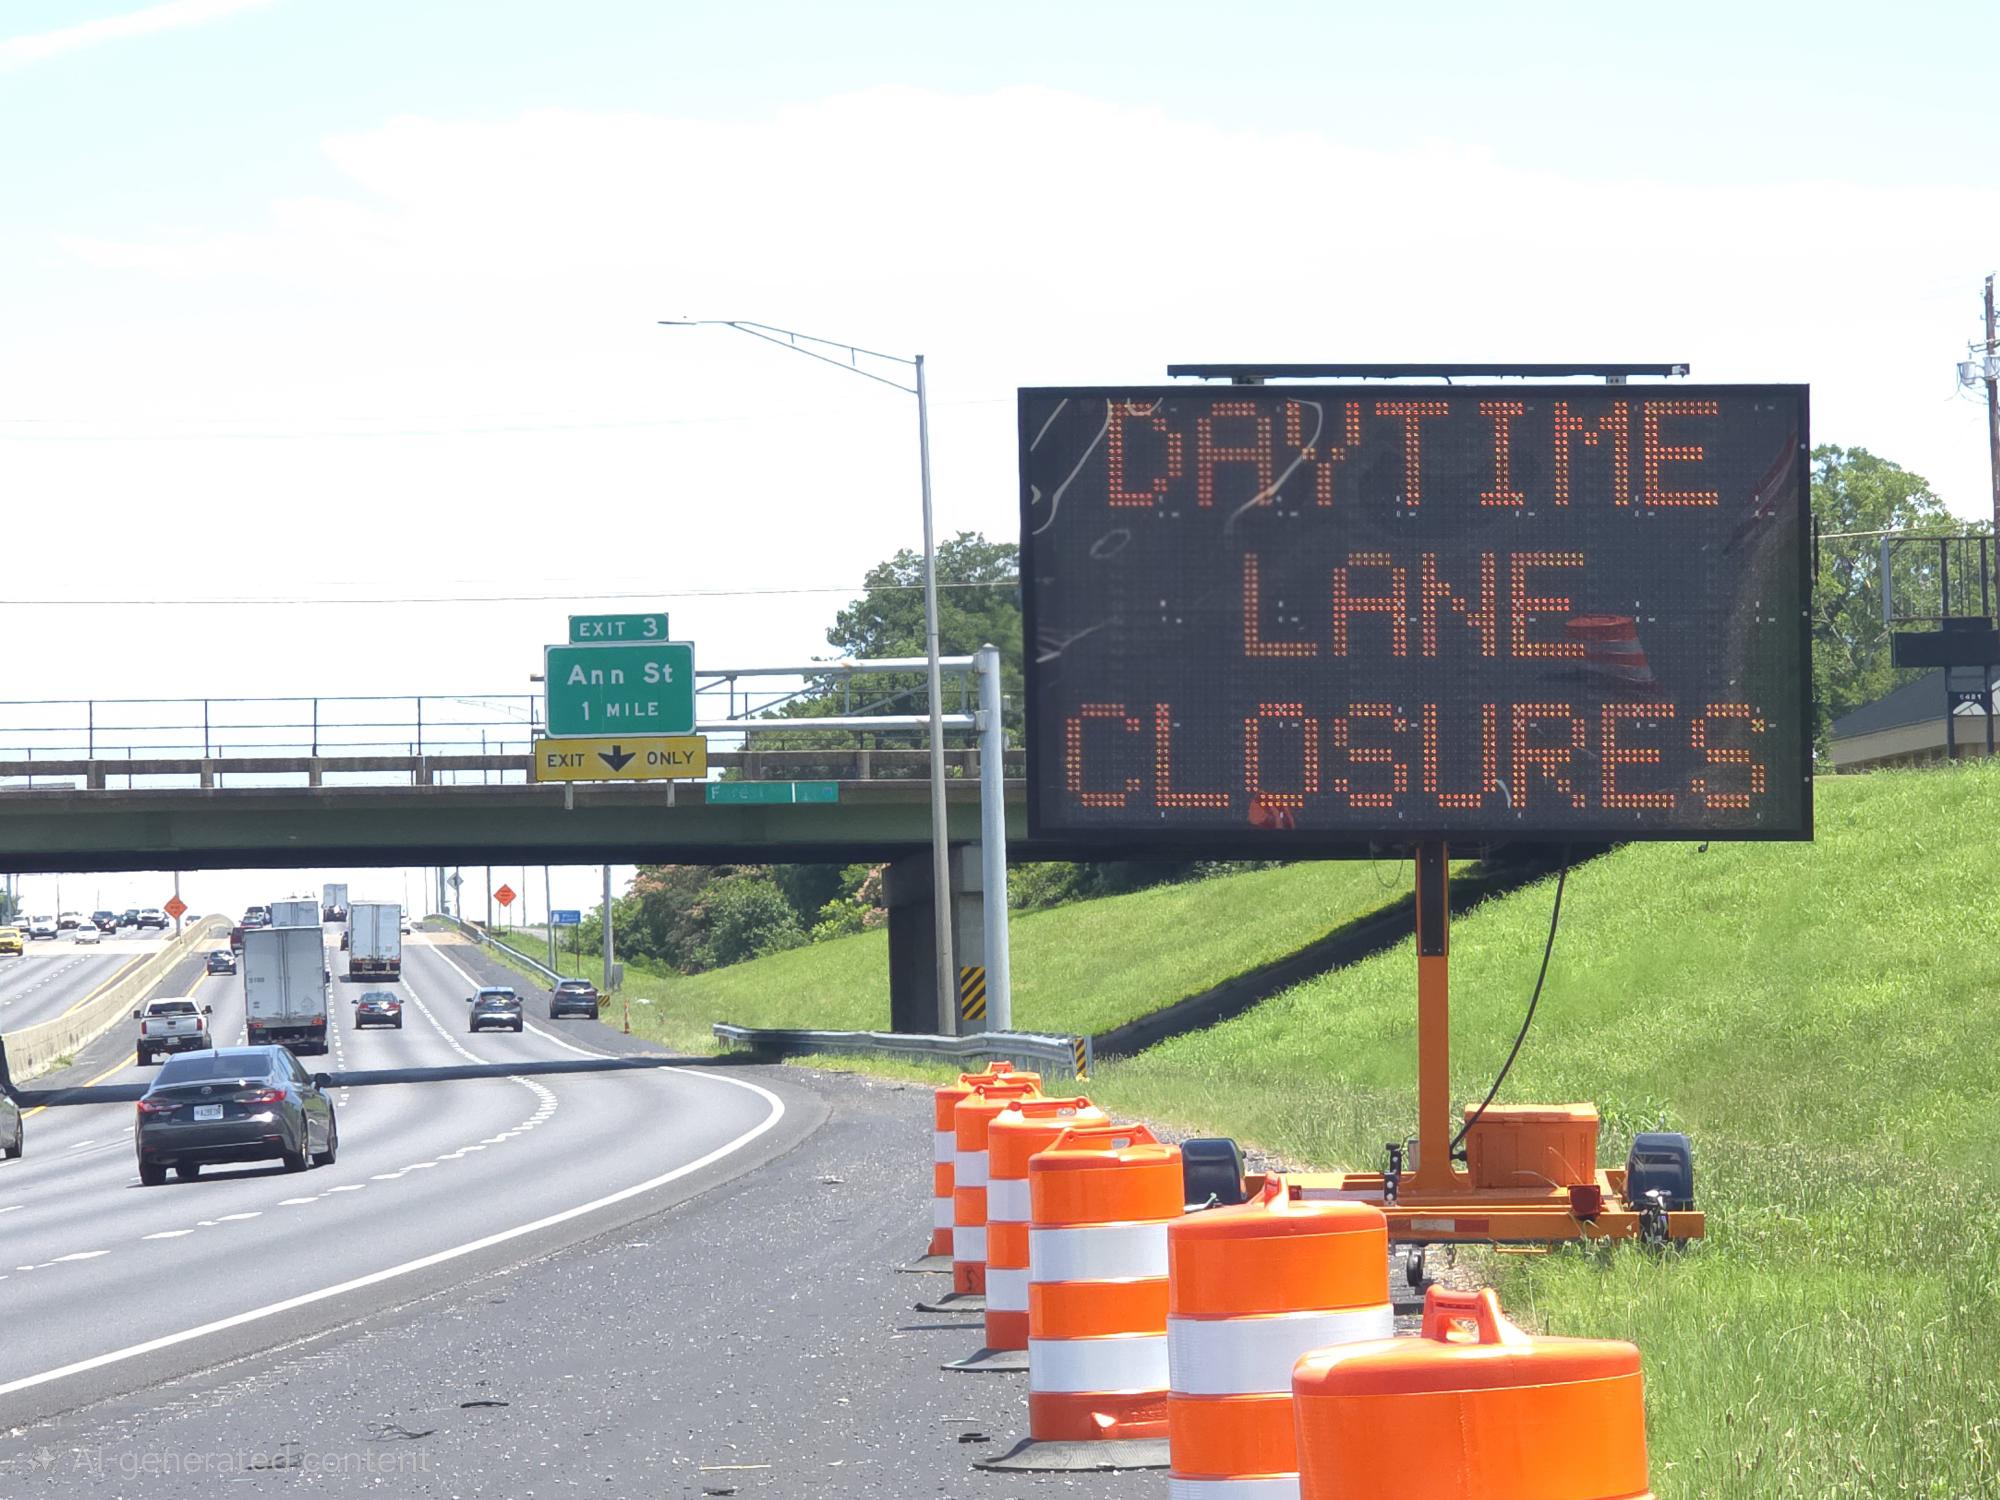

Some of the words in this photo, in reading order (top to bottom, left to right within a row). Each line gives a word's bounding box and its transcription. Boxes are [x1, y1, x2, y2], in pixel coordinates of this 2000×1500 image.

[1107, 402, 1719, 506] DAYTIME
[1243, 552, 1585, 658] LANE
[579, 622, 625, 637] EXIT
[643, 618, 658, 637] 3
[567, 665, 624, 685] Ann
[643, 662, 673, 683] St
[582, 701, 590, 721] 1
[606, 702, 659, 717] MILE
[547, 753, 585, 767] EXIT
[647, 750, 694, 765] ONLY
[1065, 703, 1767, 808] CLOSURES
